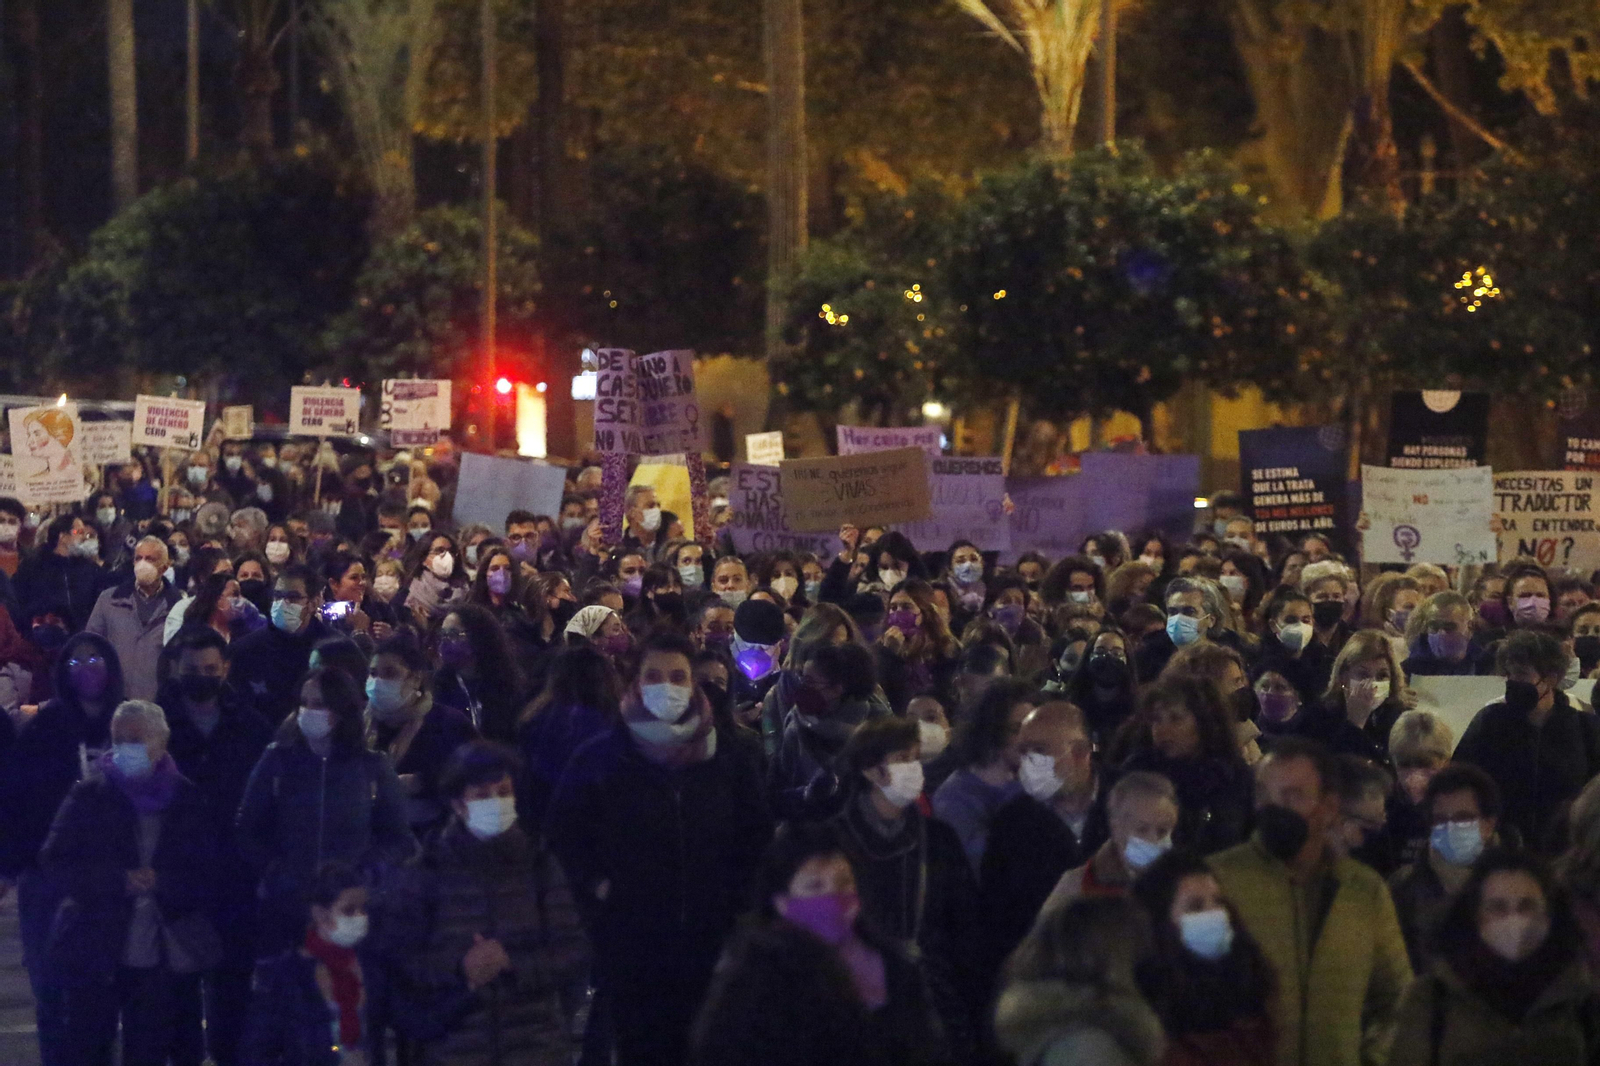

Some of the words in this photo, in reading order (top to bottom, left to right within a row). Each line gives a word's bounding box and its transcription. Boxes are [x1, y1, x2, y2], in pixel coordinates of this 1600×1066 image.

[598, 351, 623, 371] DE
[303, 396, 344, 406] VIOLENCIA
[147, 406, 189, 419] VIOLENCIA
[302, 407, 312, 416] DE
[146, 417, 156, 426] DE
[302, 418, 322, 426] CERO
[145, 427, 166, 437] CERO
[595, 429, 615, 451] NO
[1422, 445, 1467, 457] PERSONAS
[932, 460, 1002, 474] QUEREMOS
[1252, 469, 1264, 479] SE
[1265, 467, 1299, 478] ESTIMA
[834, 480, 876, 501] VIVAS
[1252, 482, 1271, 493] QUE
[1272, 481, 1285, 491] LA
[1285, 479, 1315, 490] TRATA
[1494, 477, 1563, 491] NECESITAS
[1575, 477, 1592, 490] UN
[1253, 494, 1289, 506] GENERA
[1312, 492, 1324, 503] DE
[1493, 493, 1592, 512] TRADUCTOR
[1255, 522, 1267, 532] DE
[1268, 520, 1298, 532] EUROS
[1300, 518, 1311, 529] AL
